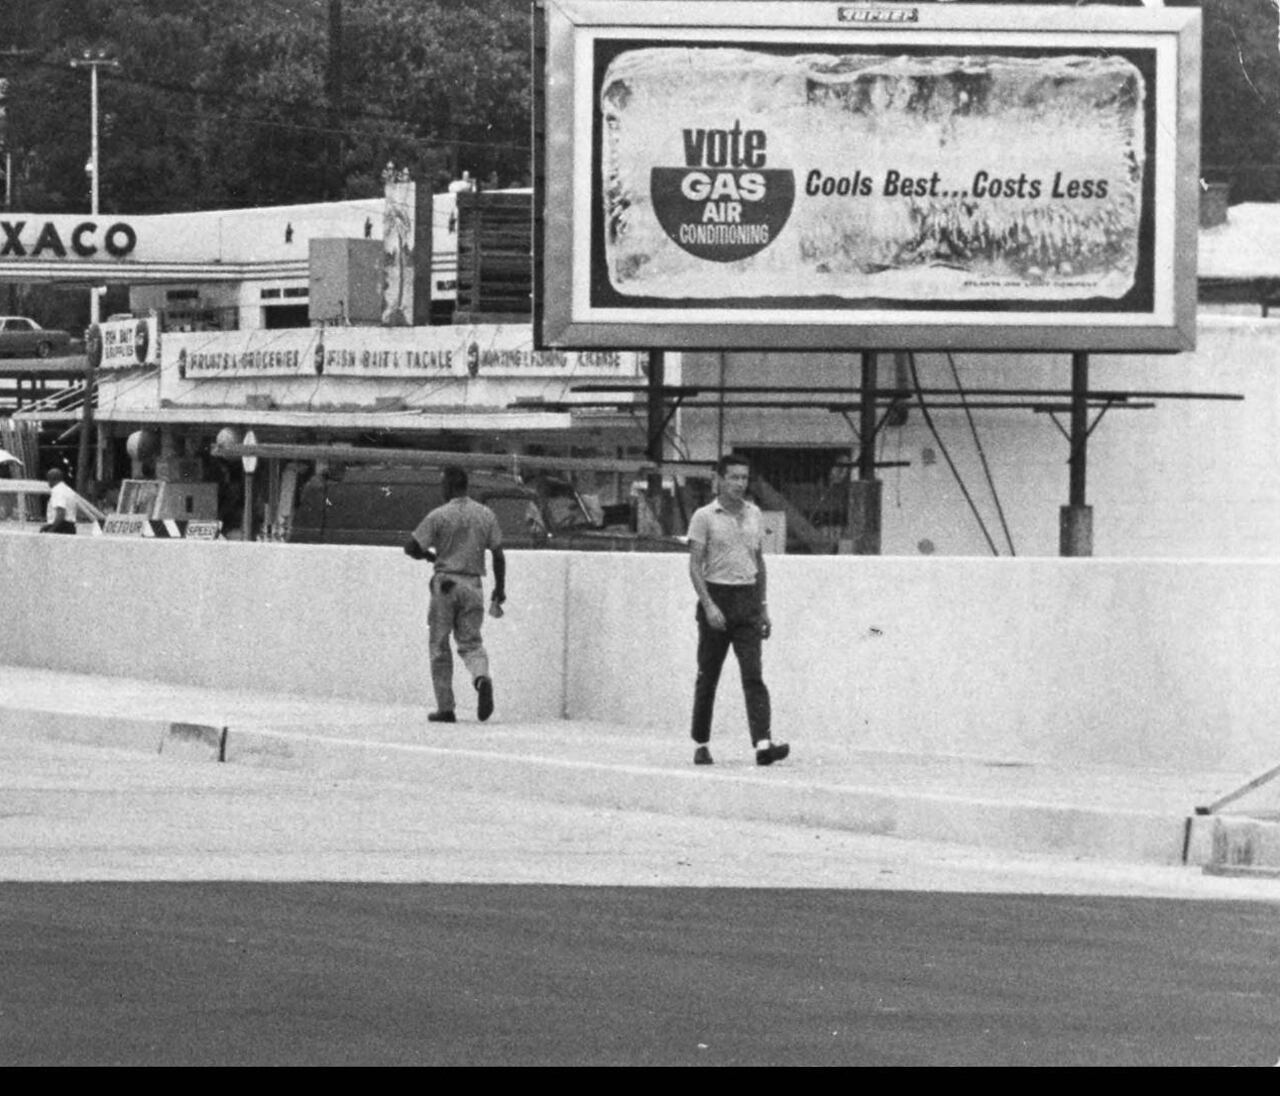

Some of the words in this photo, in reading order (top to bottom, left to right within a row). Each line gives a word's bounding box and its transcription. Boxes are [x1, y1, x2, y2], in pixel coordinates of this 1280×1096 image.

[683, 119, 767, 168] vote
[681, 172, 767, 200] GAS
[805, 169, 873, 197] Cools
[1051, 172, 1109, 199] Less
[702, 202, 742, 222] AIR
[679, 223, 769, 245] CONDITIONING
[241, 350, 299, 369] GROCERIES
[406, 350, 453, 369] TACKLE
[104, 520, 142, 534] DETOUR
